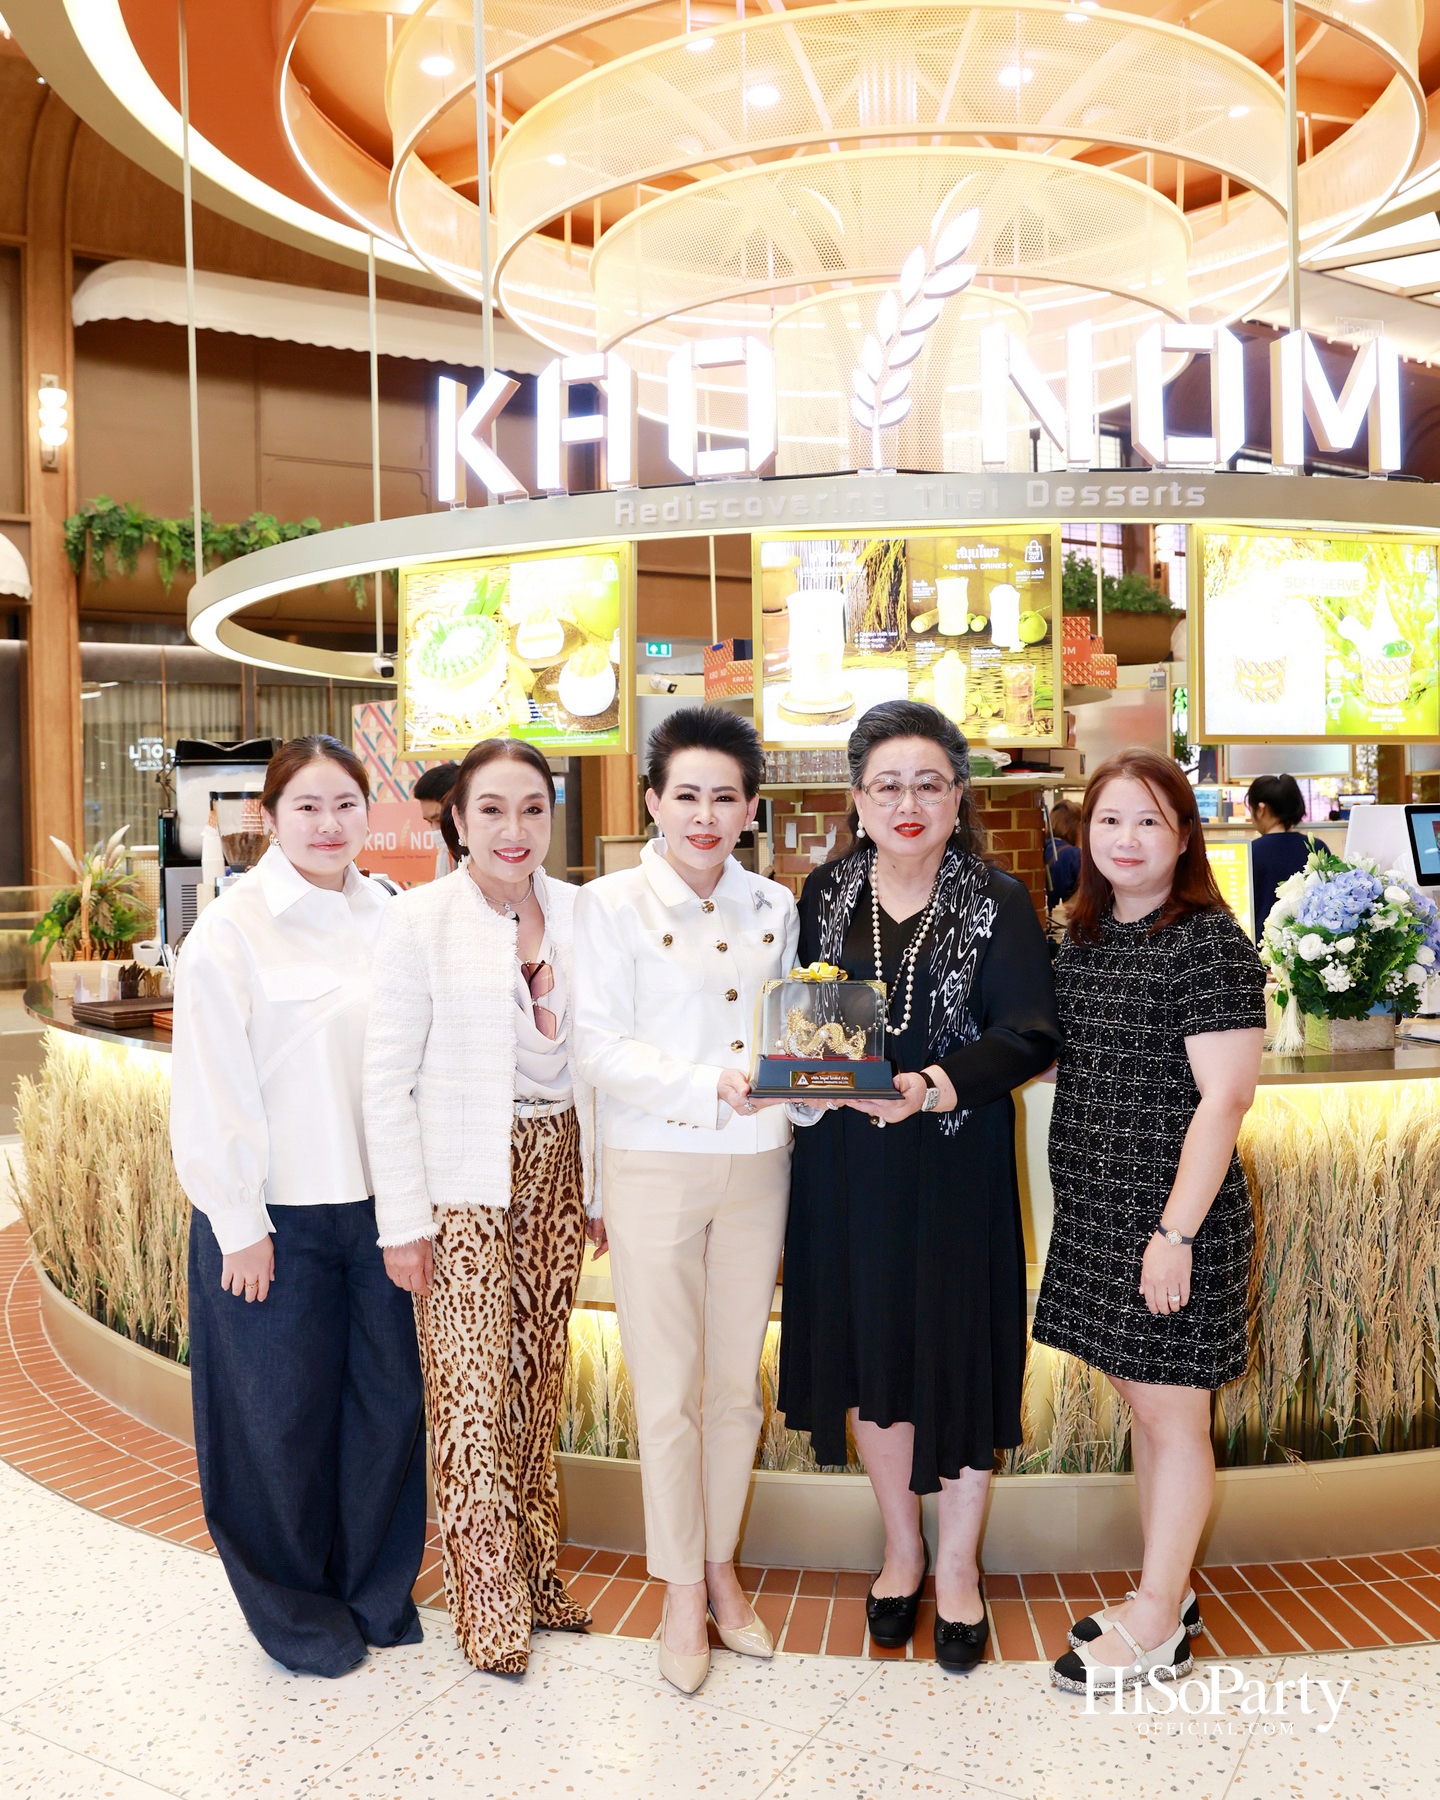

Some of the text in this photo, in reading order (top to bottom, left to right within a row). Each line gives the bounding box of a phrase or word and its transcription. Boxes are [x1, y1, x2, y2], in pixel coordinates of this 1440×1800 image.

[438, 319, 1402, 502] KAO NOM
[614, 479, 1206, 526] Rediscovering Thai Desserts
[956, 544, 1000, 563] สมุนไพร
[979, 562, 1007, 570] DRINKS
[1285, 576, 1360, 591] SOFT SERVE
[1062, 646, 1076, 655] OM
[364, 831, 435, 851] KAO NO
